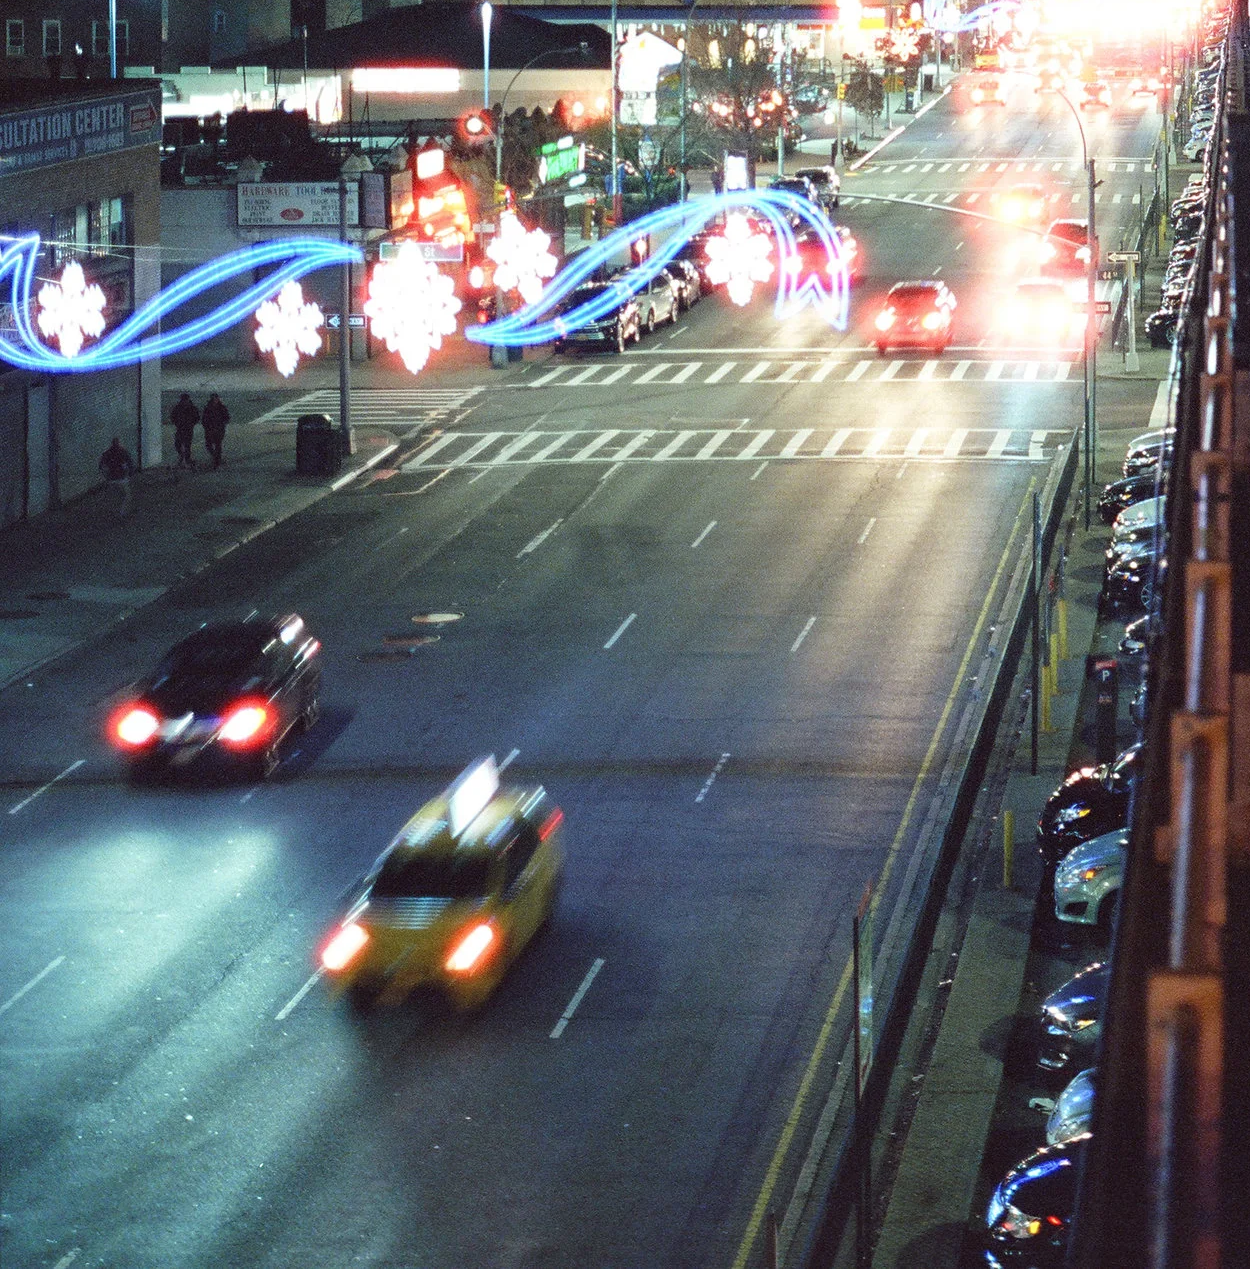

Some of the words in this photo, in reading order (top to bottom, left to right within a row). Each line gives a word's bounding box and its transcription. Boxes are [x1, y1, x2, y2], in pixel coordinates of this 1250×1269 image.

[75, 103, 124, 136] CENTER
[241, 186, 290, 197] HARDWARE
[424, 246, 435, 257] St
[1102, 670, 1110, 682] P
